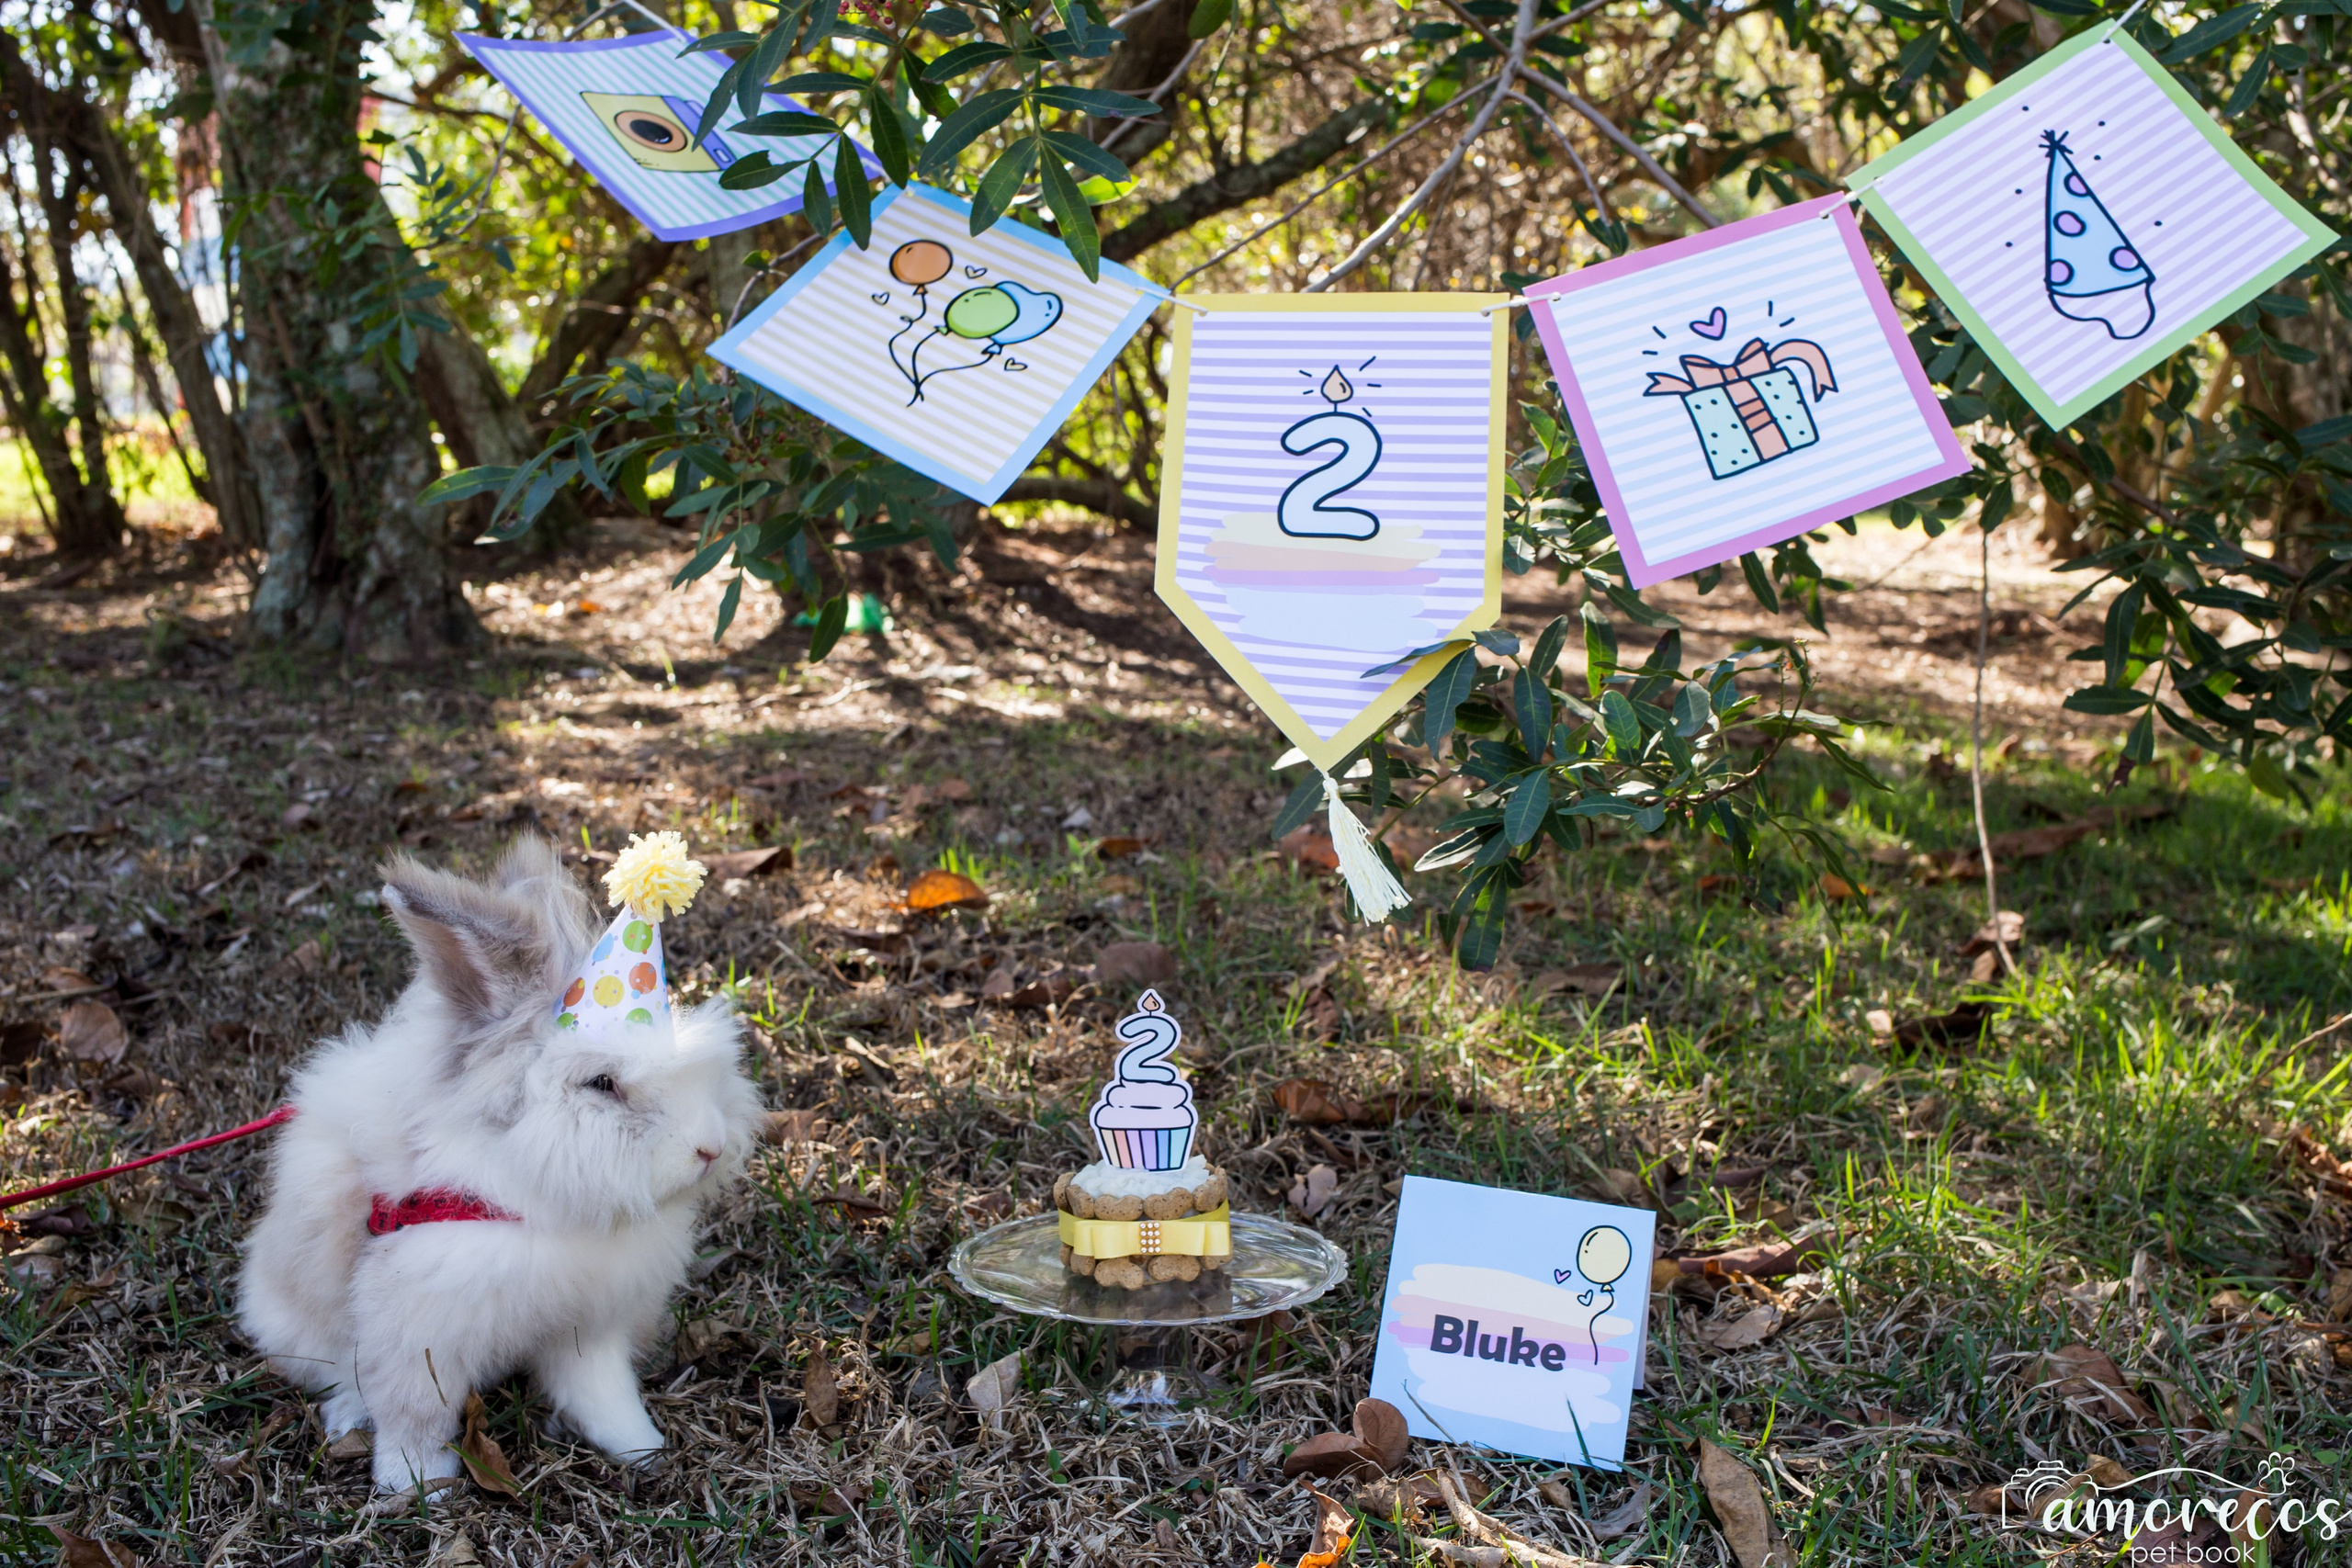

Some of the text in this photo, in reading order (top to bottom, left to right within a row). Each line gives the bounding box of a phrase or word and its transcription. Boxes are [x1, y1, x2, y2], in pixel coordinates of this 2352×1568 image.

[1277, 411, 1383, 542] 2
[1119, 1015, 1177, 1084] 2
[1430, 1314, 1566, 1372] Bluke
